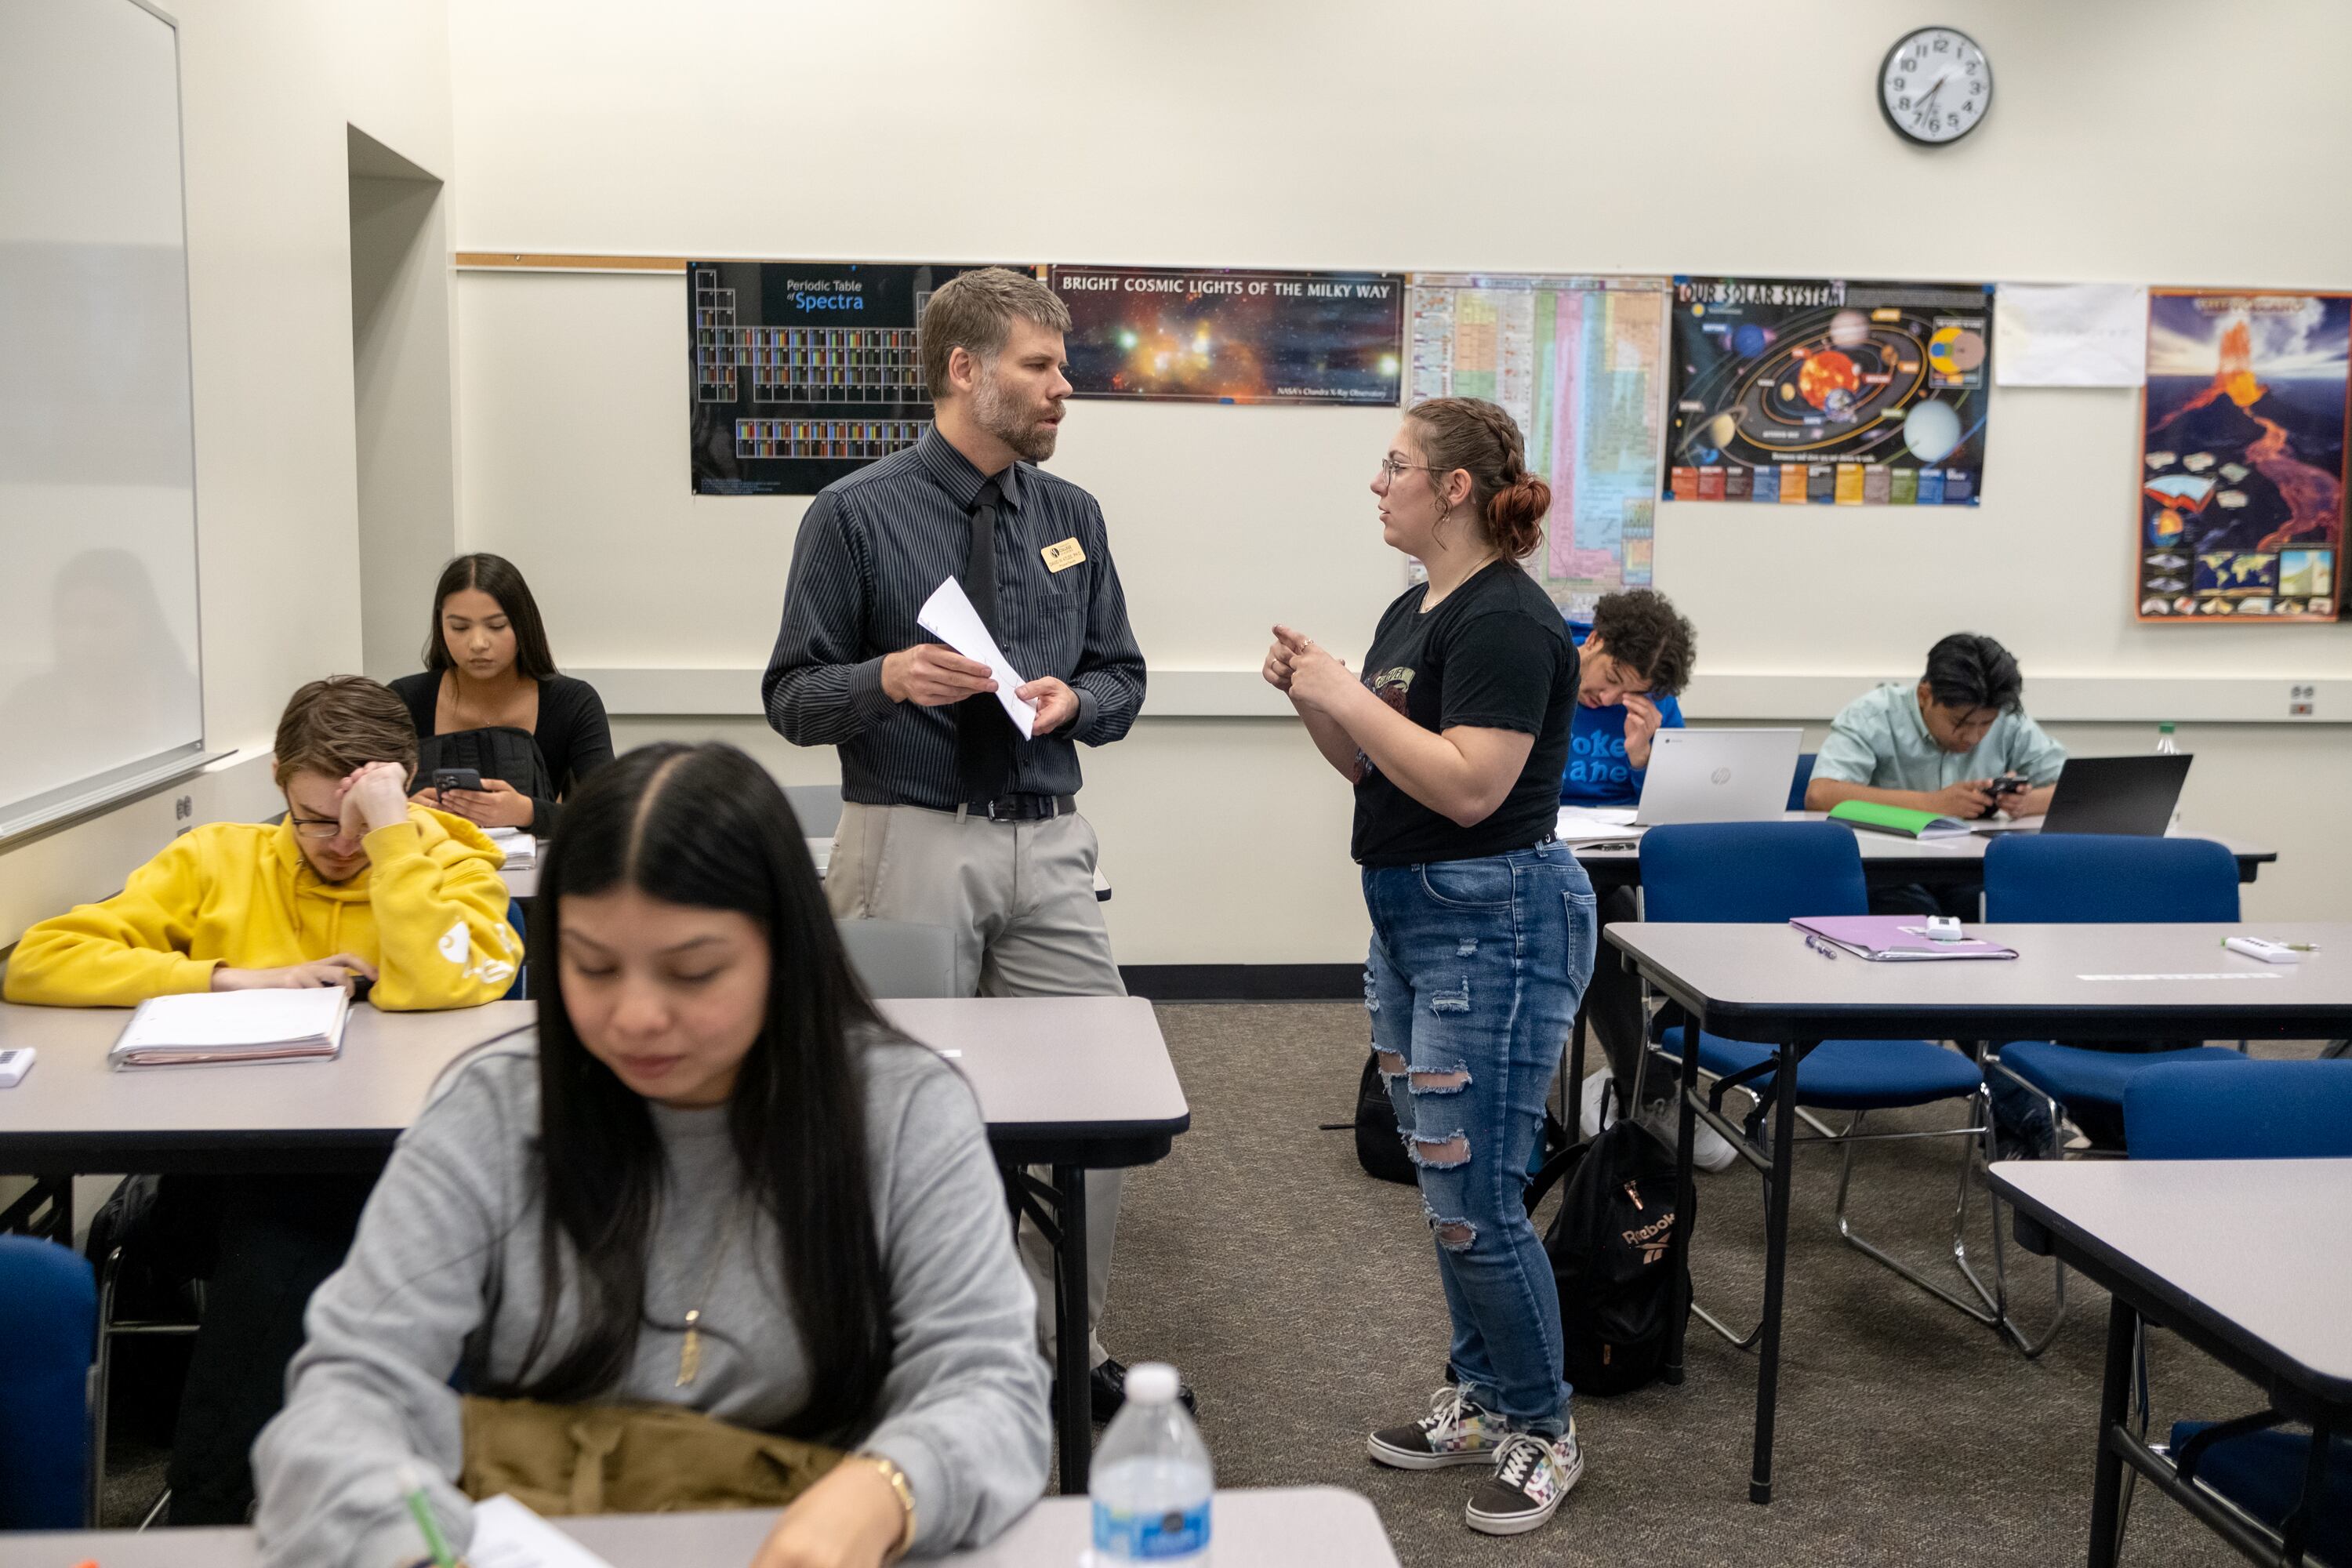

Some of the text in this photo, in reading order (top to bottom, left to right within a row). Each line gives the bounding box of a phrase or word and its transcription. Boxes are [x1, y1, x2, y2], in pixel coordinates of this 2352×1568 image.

[1915, 45, 1928, 57] 11
[1933, 39, 1949, 53] 12
[1900, 59, 1918, 72] 10
[1965, 60, 1976, 75] 2
[1893, 78, 1905, 92] 9
[1969, 81, 1981, 95] 3
[1898, 96, 1911, 111] 8
[1962, 100, 1973, 112] 4
[1913, 111, 1922, 125] 7
[1929, 118, 1940, 132] 6
[1947, 113, 1959, 126] 5
[786, 278, 862, 292] Periodic Table
[1062, 276, 1390, 299] BRIGHT COSMIC LIGHTS OF THE MILKY WAY
[786, 291, 864, 313] of Spectra
[1685, 283, 1715, 303] OUR
[1725, 284, 1773, 304] SOLAR
[1782, 285, 1842, 307] SYSTEM
[1571, 728, 1627, 759] oke
[1621, 1212, 1675, 1245] Reebok
